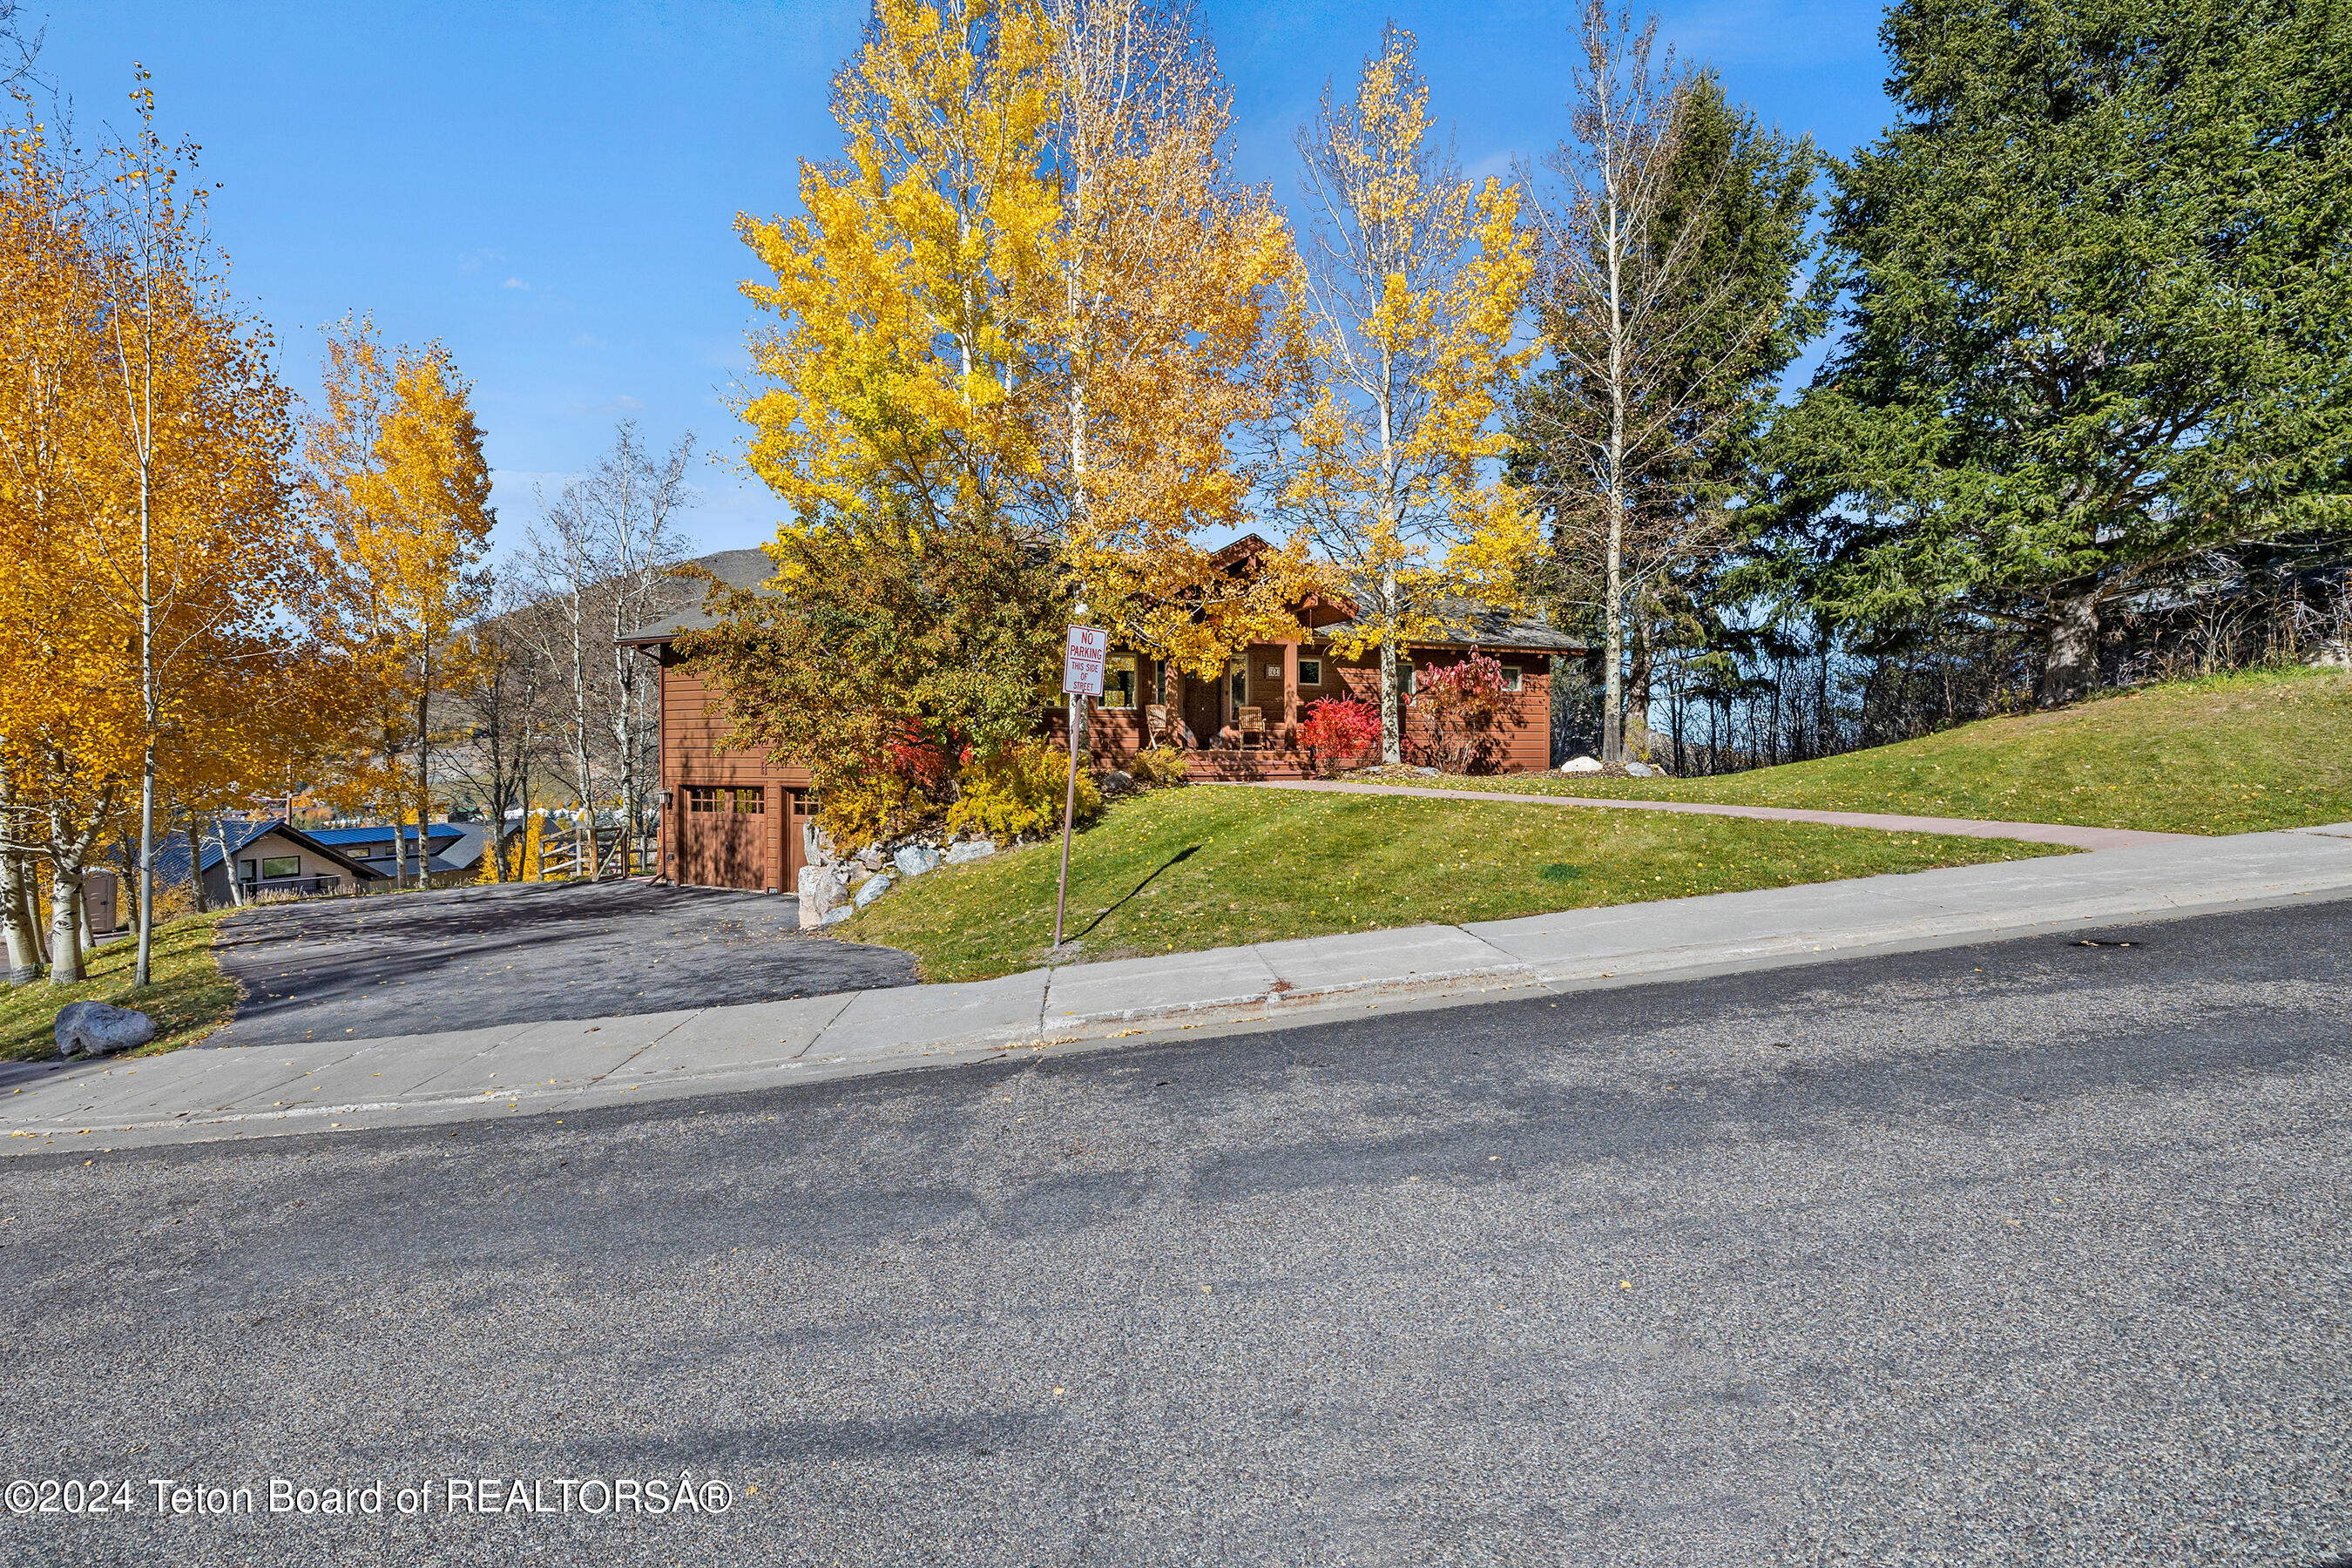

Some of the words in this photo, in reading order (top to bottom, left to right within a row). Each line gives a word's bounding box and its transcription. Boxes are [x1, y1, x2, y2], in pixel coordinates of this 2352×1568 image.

[1081, 632, 1093, 645] NO
[1070, 645, 1102, 659] PARKING
[1071, 661, 1084, 671] THIS
[1085, 663, 1098, 672] SIDE
[1073, 681, 1093, 691] STREET
